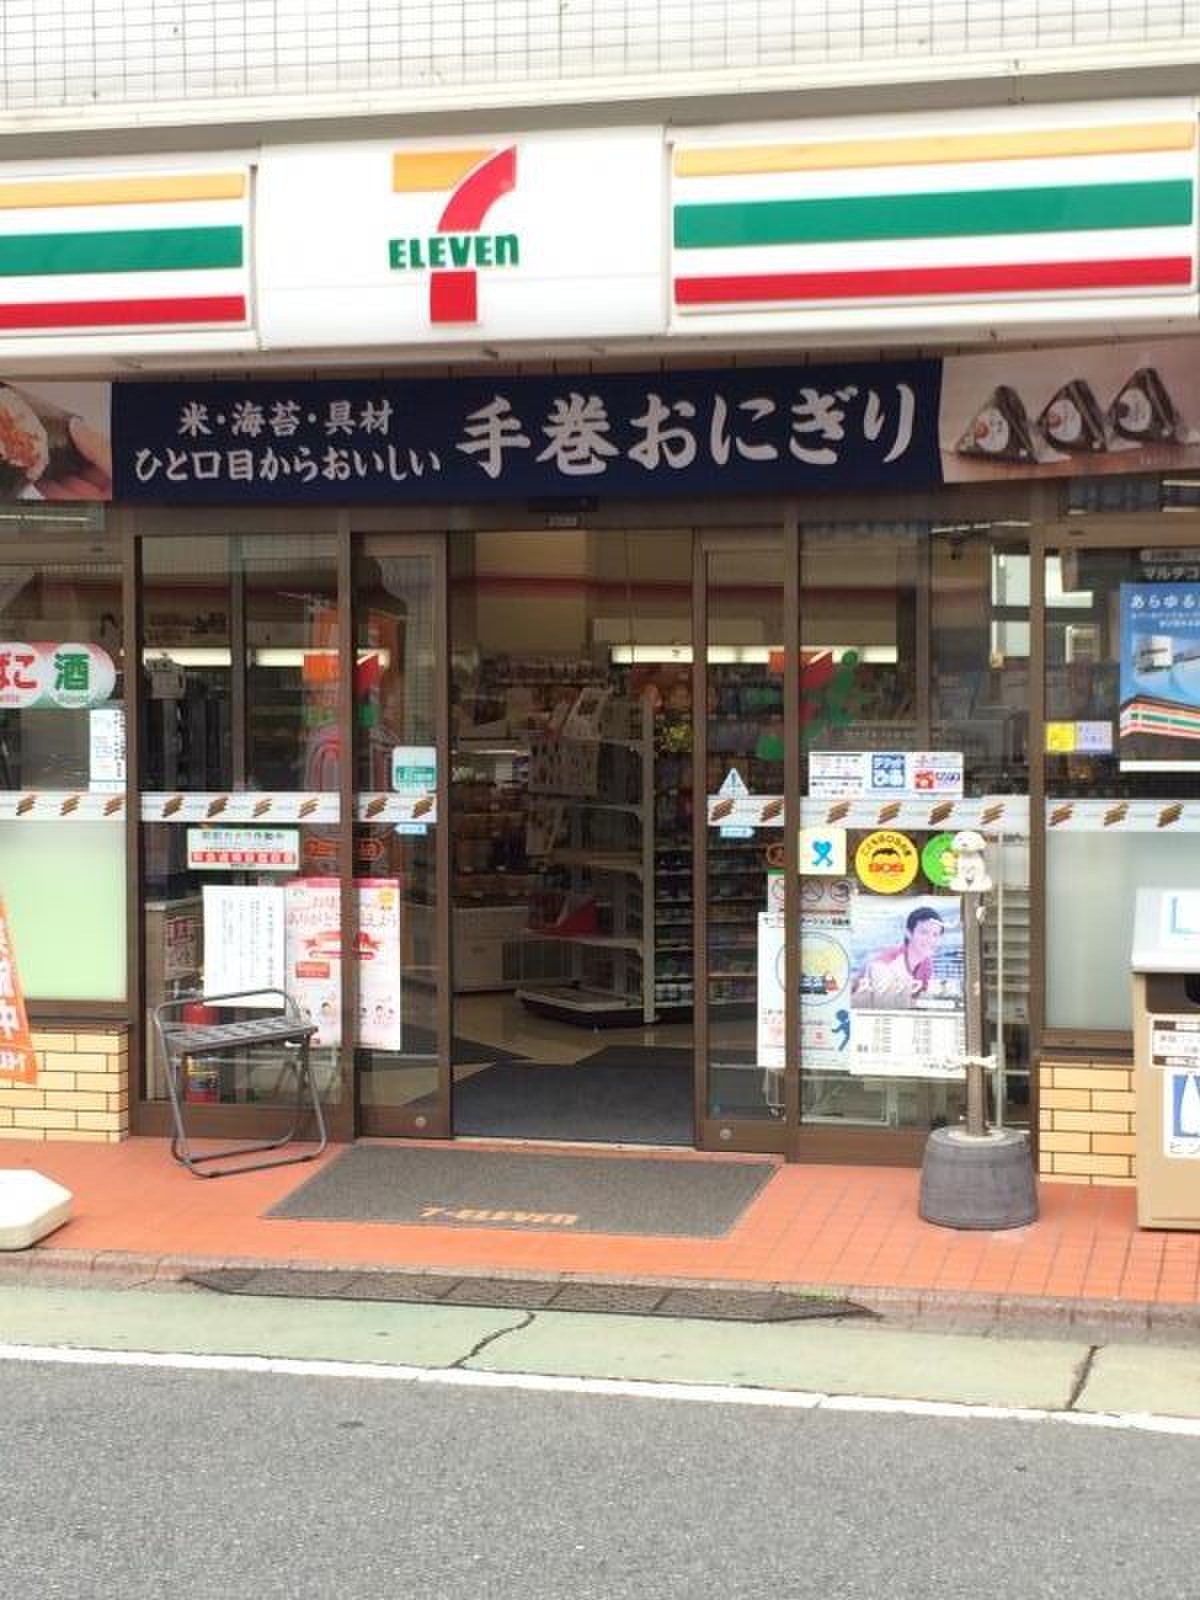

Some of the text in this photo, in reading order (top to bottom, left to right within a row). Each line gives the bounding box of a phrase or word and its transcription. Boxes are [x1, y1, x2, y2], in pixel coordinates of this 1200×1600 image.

[391, 146, 518, 325] 7
[180, 401, 393, 438] 米・海苔・具材
[456, 382, 915, 480] 手巻おにぎり
[135, 444, 442, 483] ひと口目からおいしい
[1130, 593, 1200, 609] あらゆる
[53, 653, 90, 691] 酒
